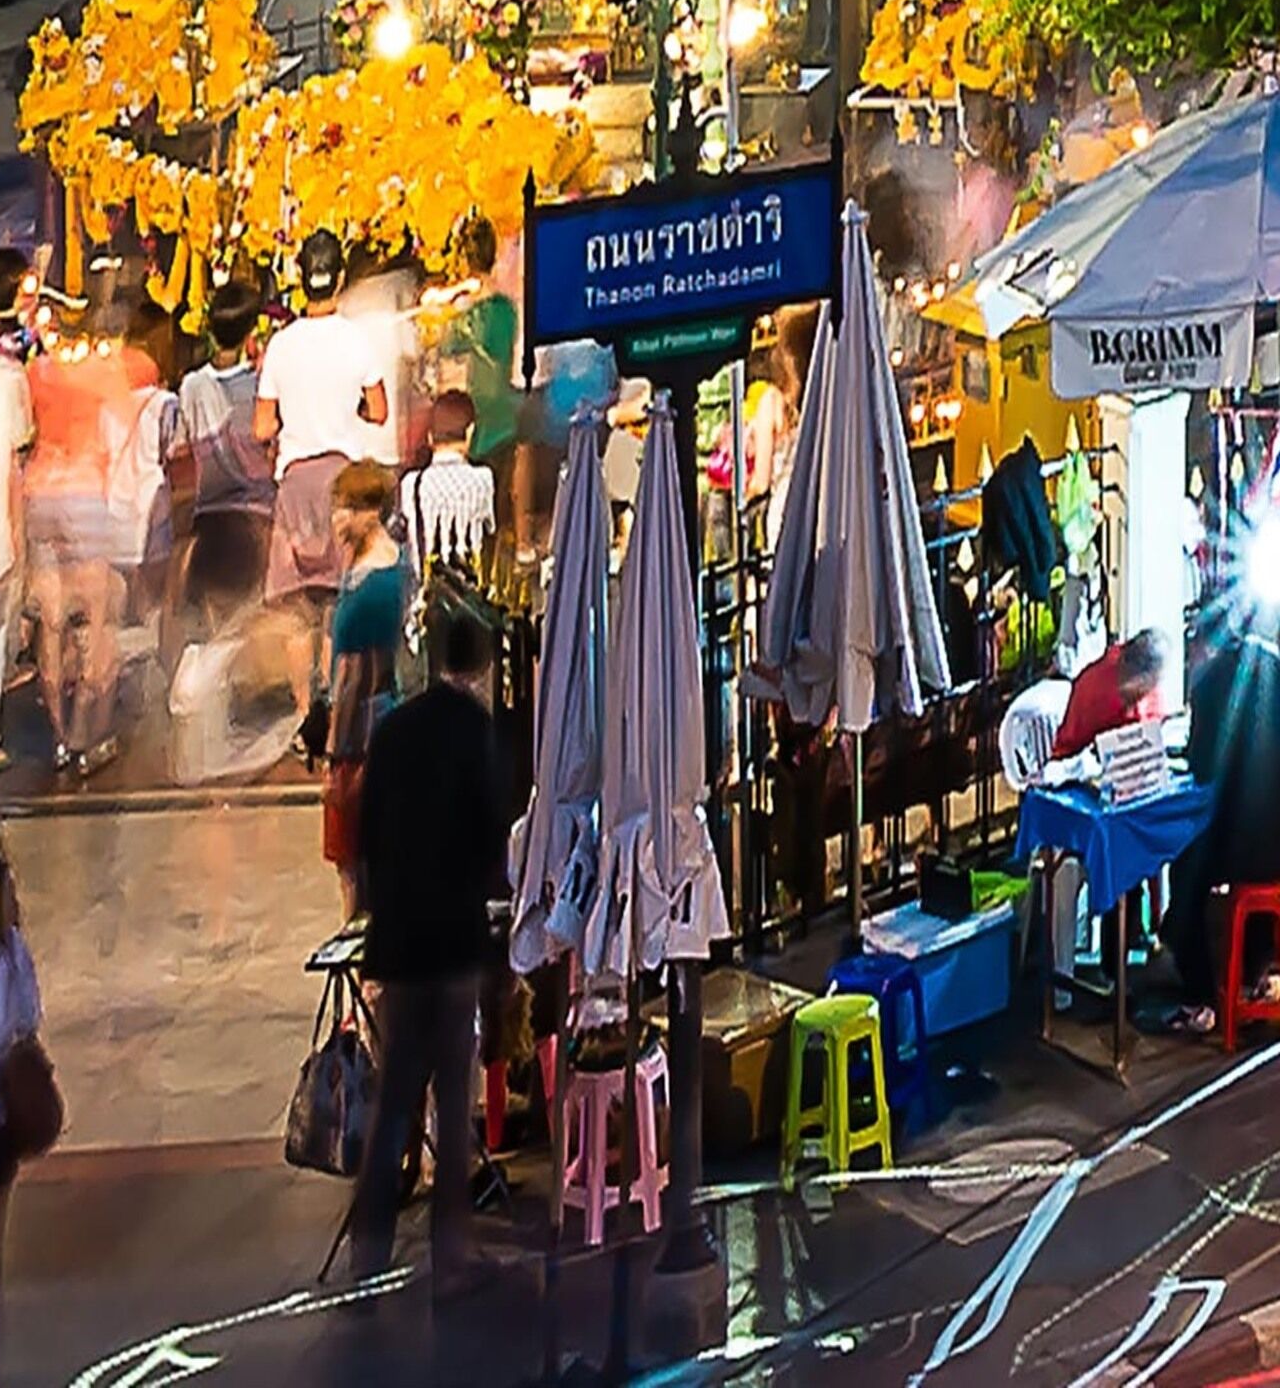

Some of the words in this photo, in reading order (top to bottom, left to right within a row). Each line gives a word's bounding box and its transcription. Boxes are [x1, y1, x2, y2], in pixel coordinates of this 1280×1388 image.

[586, 193, 782, 273] ถนนราชดำริ
[584, 284, 655, 309] Thanon
[662, 258, 781, 294] Ratchadamri
[1090, 323, 1223, 364] B.GRIMM
